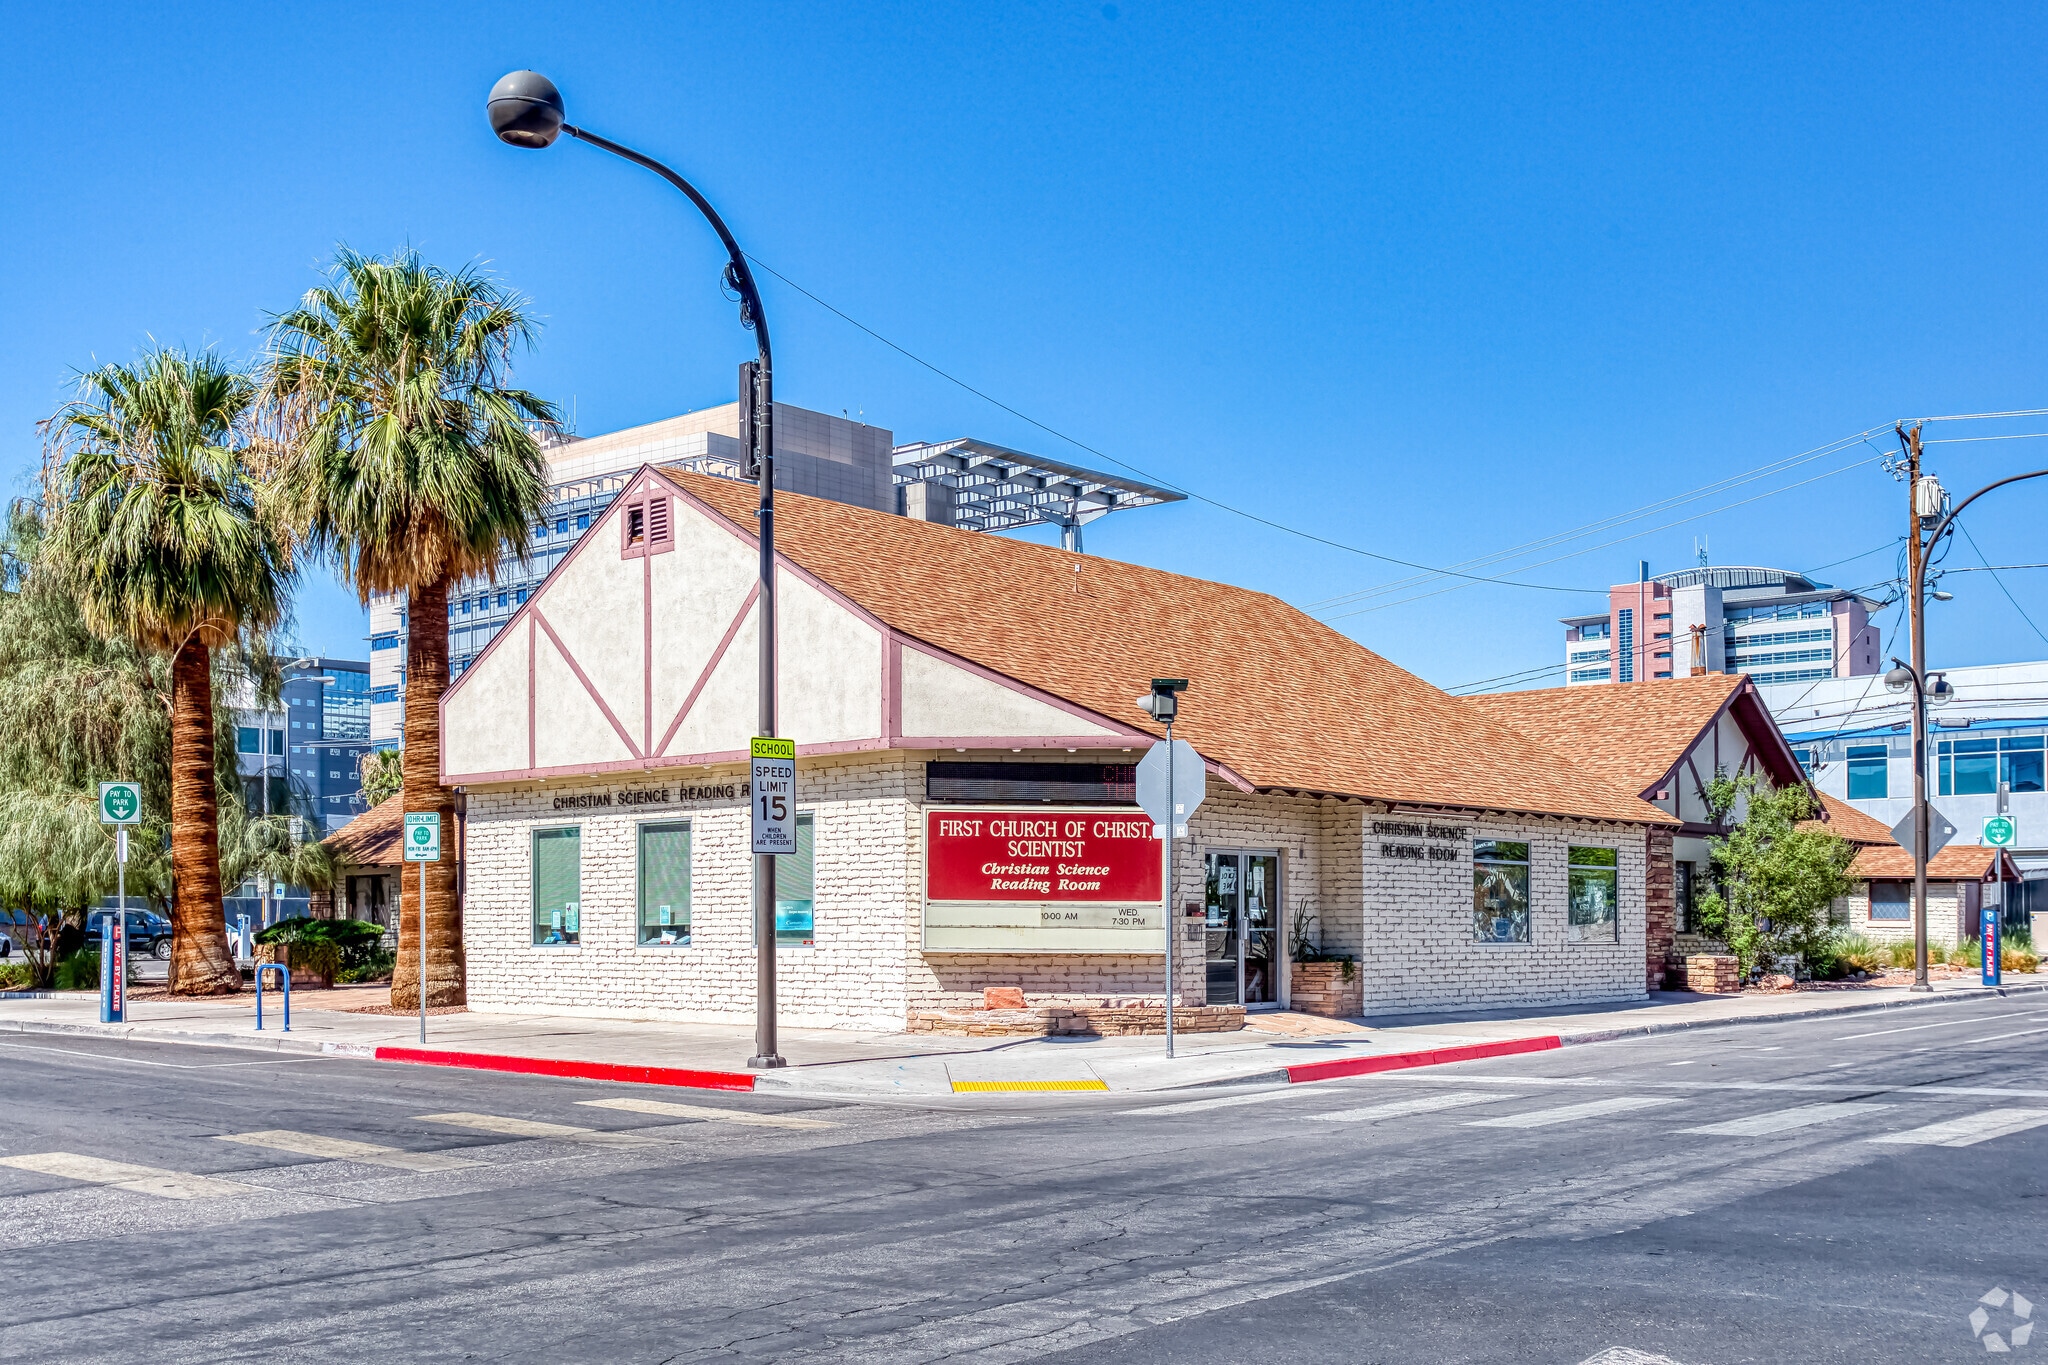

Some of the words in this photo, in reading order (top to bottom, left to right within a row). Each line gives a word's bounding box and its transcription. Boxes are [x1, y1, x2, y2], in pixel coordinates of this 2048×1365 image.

[754, 742, 792, 756] SCHOOL
[756, 766, 792, 778] SPEED
[760, 781, 788, 792] LIMIT
[553, 794, 611, 809] CHRISTIAN
[617, 790, 670, 805] SCIENCE
[680, 785, 734, 802] READING
[760, 796, 787, 822] 15
[940, 820, 982, 837] FIRST
[990, 820, 1057, 837] CHURCH
[1064, 821, 1086, 837] OF
[1093, 821, 1152, 842] CHRIST,
[1373, 822, 1422, 836] CHRISTIAN
[1427, 825, 1467, 840] SCIENCE
[1008, 842, 1086, 858] SCIENTIST
[1382, 844, 1424, 859] READING
[1429, 846, 1458, 861] ROOM
[982, 862, 1050, 876] Christian
[1056, 862, 1110, 876] Science
[990, 878, 1050, 893] Reading
[1058, 879, 1100, 890] Room
[1987, 911, 1994, 920] P
[115, 966, 121, 977] BY
